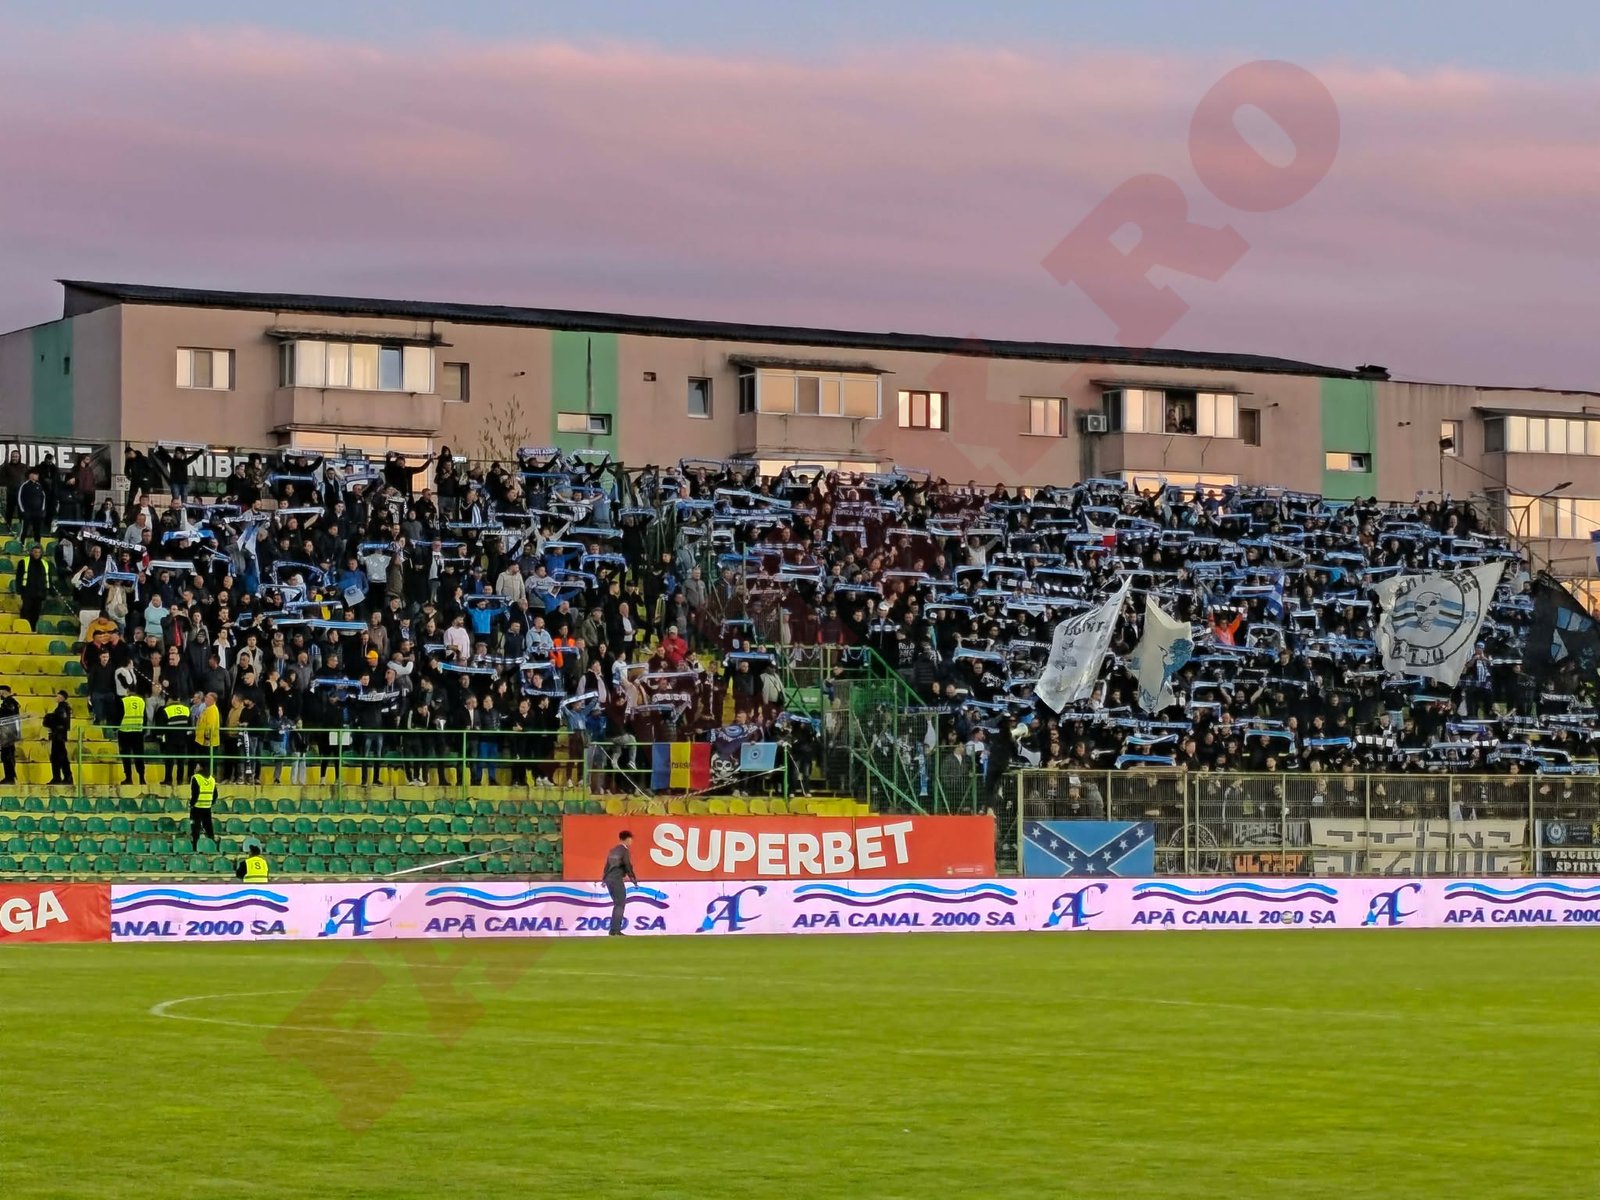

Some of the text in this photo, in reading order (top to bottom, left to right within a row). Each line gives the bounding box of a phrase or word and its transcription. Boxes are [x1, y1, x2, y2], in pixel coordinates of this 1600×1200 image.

[650, 821, 913, 875] SUPERBET
[254, 861, 262, 870] S
[0, 890, 69, 934] GA
[847, 912, 924, 927] CANAL
[930, 911, 981, 927] 2000
[985, 911, 1016, 926] SA
[1181, 910, 1254, 925] CANAL
[1258, 910, 1304, 925] 200
[1308, 910, 1337, 924] SA
[1490, 909, 1558, 923] CANAL
[185, 919, 244, 936] 2000
[250, 919, 287, 936] SA
[484, 916, 569, 932] CANAL
[634, 915, 667, 931] SA
